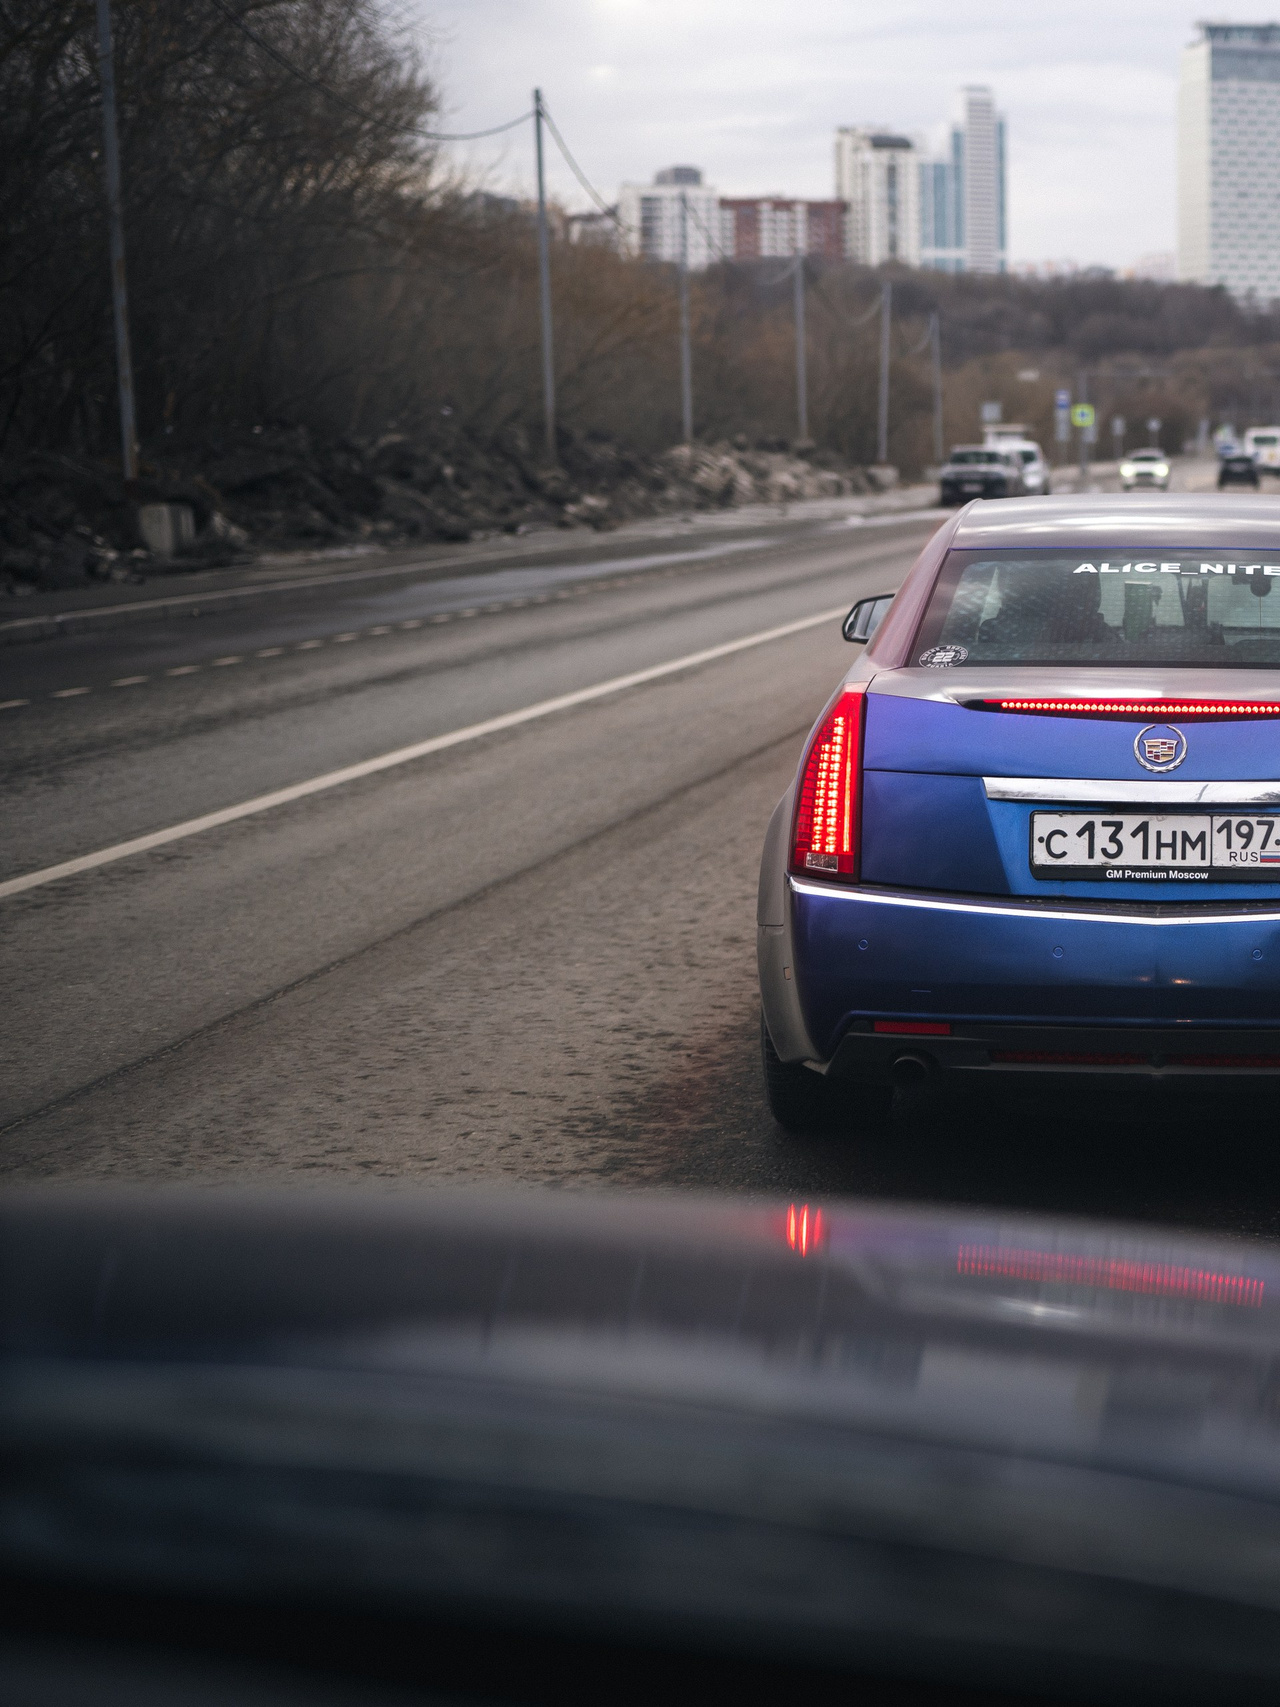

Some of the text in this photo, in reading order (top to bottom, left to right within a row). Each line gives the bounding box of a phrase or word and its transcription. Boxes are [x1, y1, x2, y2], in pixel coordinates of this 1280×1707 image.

[932, 652, 956, 663] 22
[1217, 819, 1275, 850] 197
[1229, 851, 1259, 862] RUS
[1106, 870, 1209, 880] GM Premium Moscow
